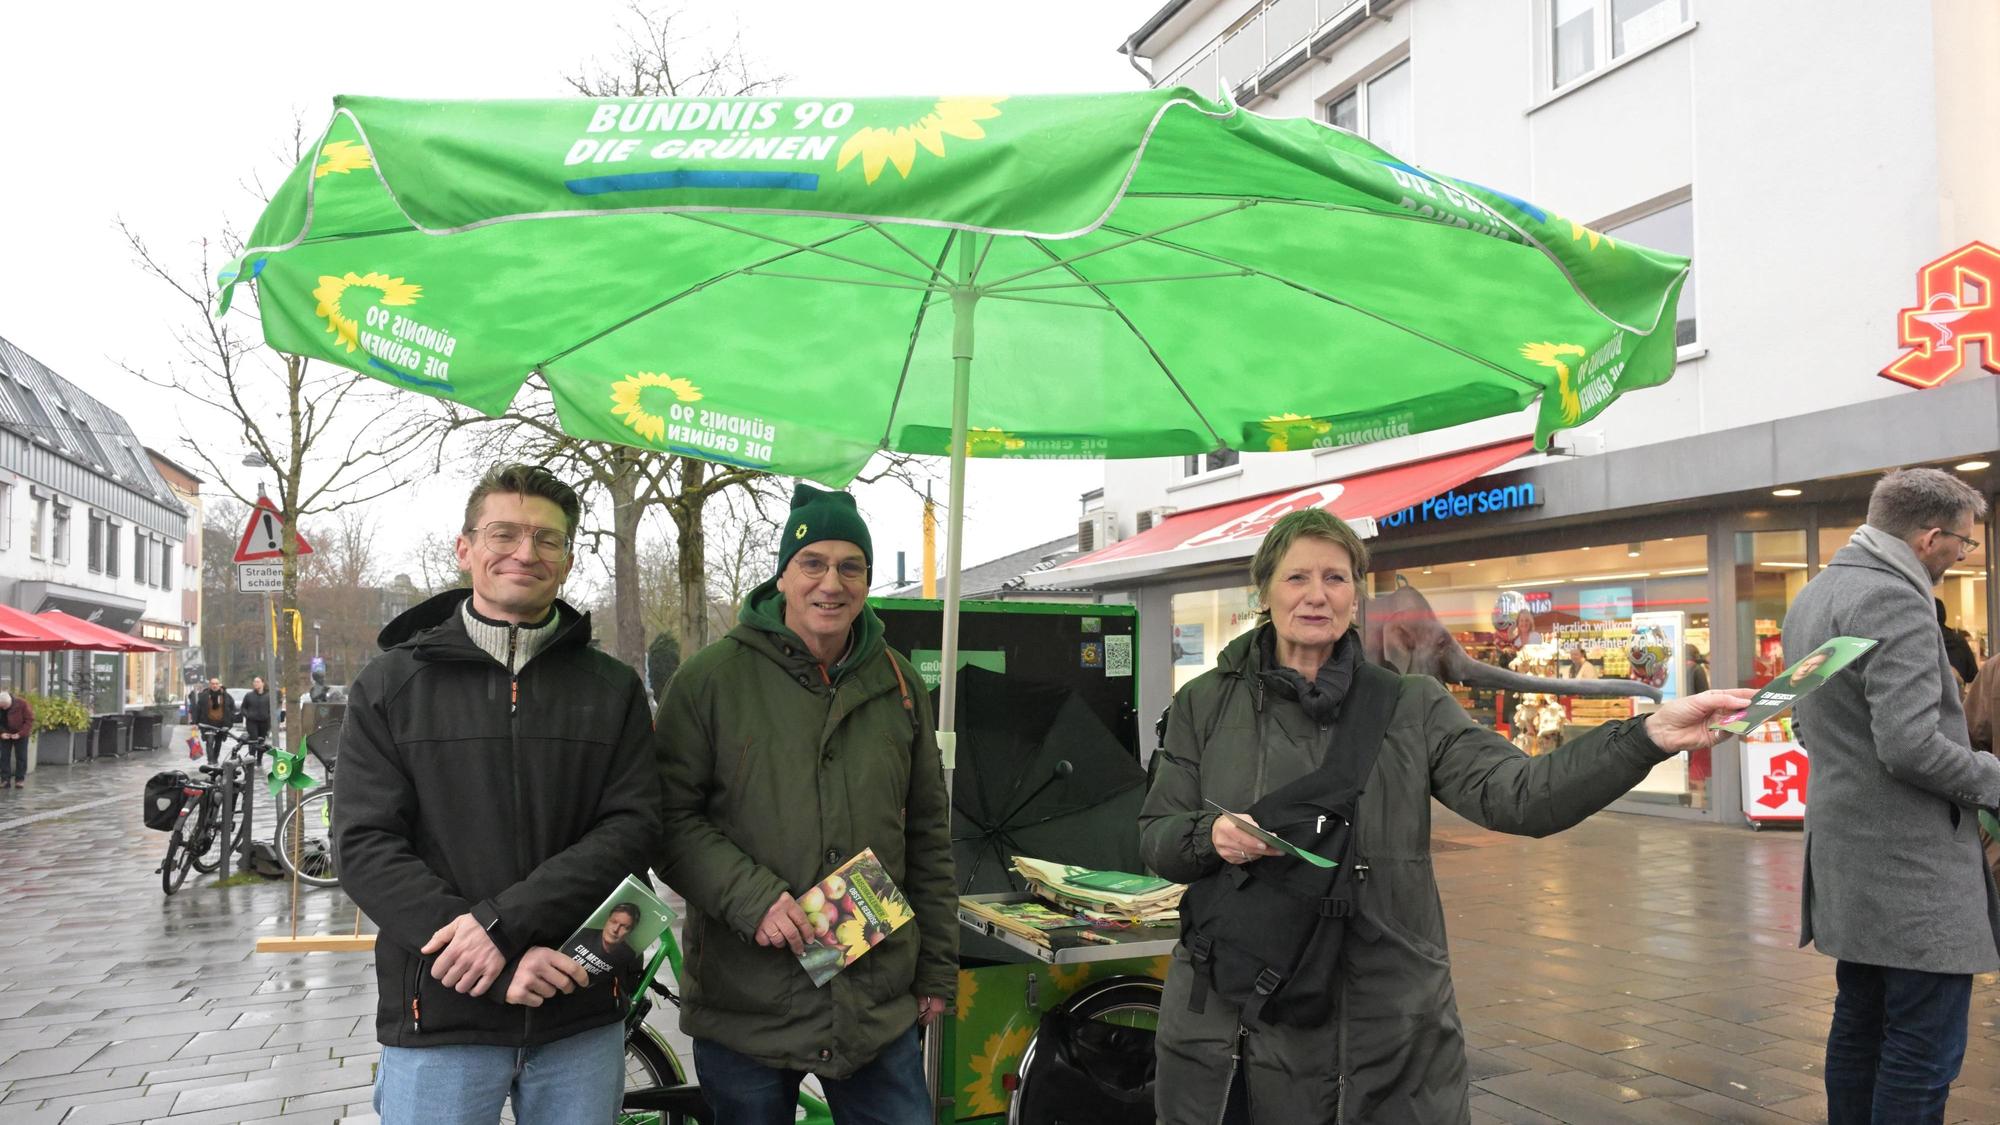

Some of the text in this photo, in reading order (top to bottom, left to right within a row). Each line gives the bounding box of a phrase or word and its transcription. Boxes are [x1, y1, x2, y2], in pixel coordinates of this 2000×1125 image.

[586, 99, 855, 133] BÜNDNIS 90
[563, 131, 839, 166] DIE GRÜNEN
[1422, 482, 1535, 522] Petersenn
[247, 578, 282, 587] schäde
[1552, 621, 1591, 634] Herzlich
[921, 660, 942, 672] GRÜ
[849, 887, 862, 901] OBST
[574, 944, 589, 958] EIN
